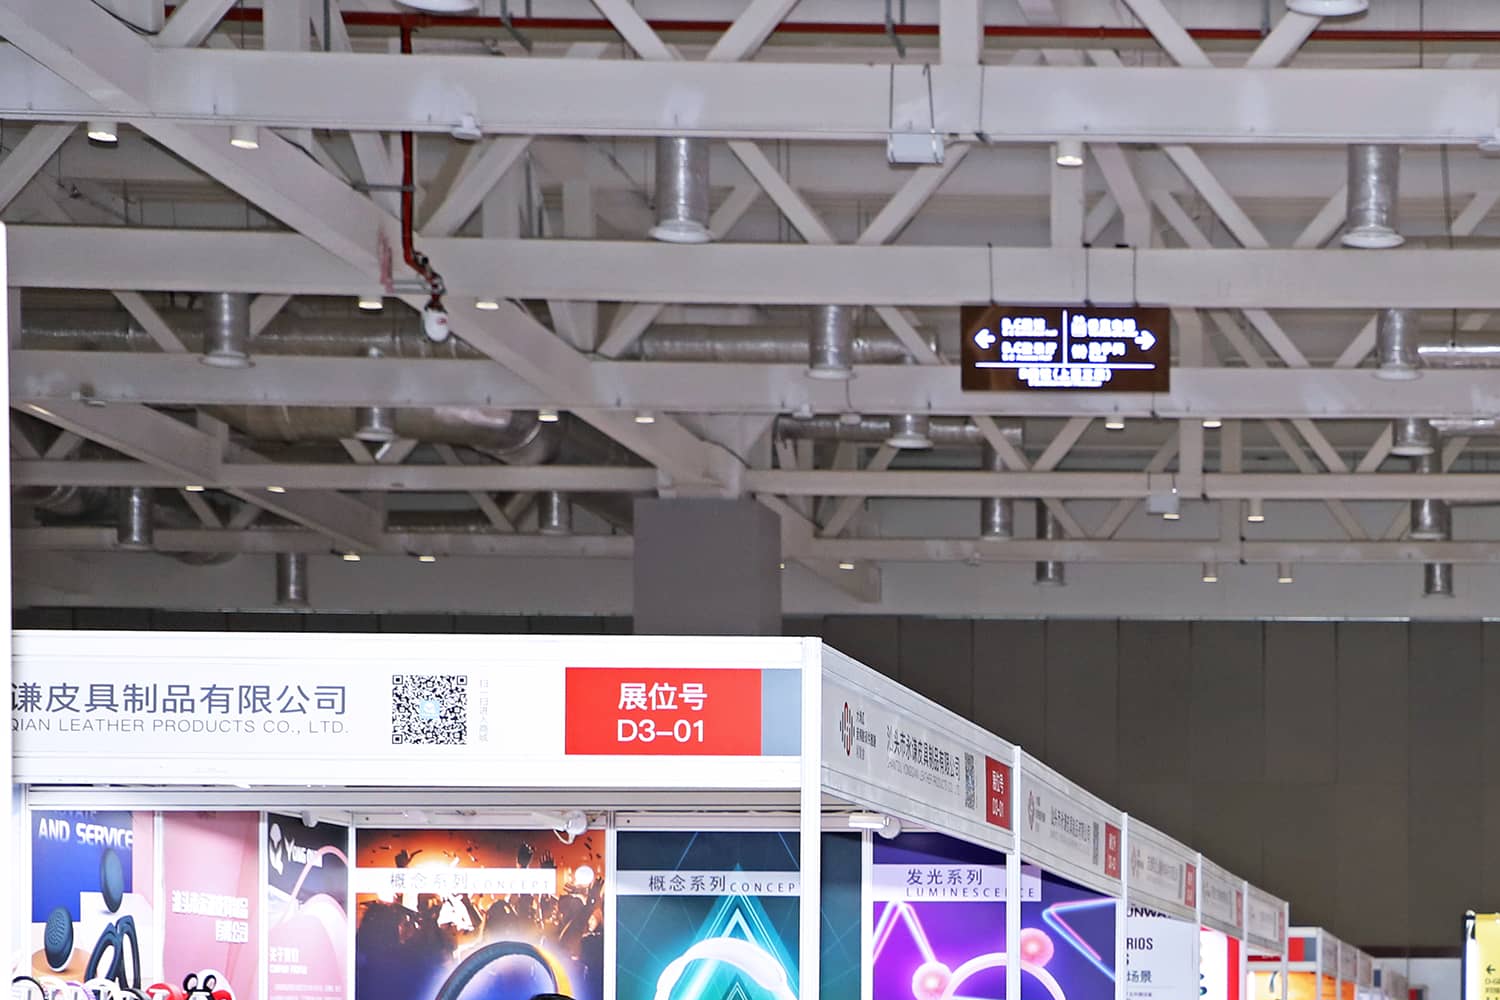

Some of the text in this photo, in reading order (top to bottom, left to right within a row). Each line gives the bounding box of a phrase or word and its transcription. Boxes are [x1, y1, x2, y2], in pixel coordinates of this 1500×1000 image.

[12, 682, 346, 715] 谦皮具制品有限公司
[618, 682, 708, 711] 展位号
[59, 719, 144, 732] LEATHER
[153, 720, 255, 733] PRODUCTS
[309, 721, 349, 733] LTD.
[617, 719, 705, 742] D3-01
[38, 817, 133, 849] AND SERVICE
[390, 871, 468, 889] 概念系列
[649, 875, 726, 892] 概念系列
[907, 868, 983, 886] 发光系列
[729, 881, 800, 893] CONCEP
[906, 887, 1035, 898] LUMINESCEE
